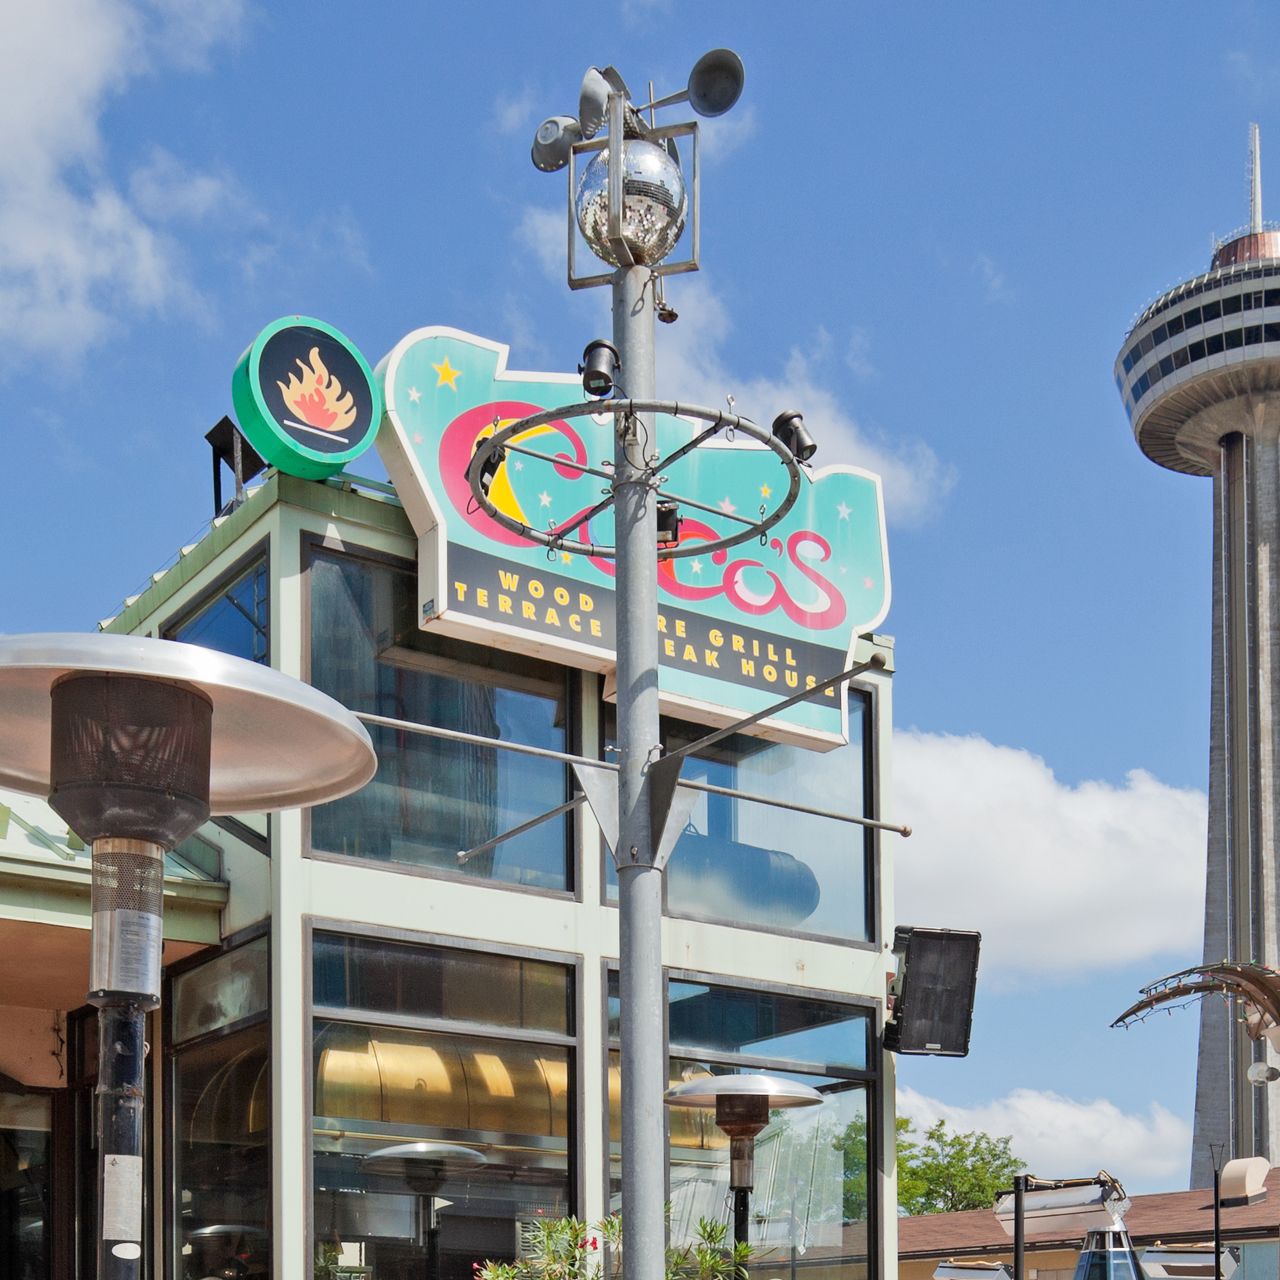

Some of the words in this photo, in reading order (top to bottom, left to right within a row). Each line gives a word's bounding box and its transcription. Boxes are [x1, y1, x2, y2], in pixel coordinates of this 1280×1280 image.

[454, 581, 602, 637] TERRACE
[664, 639, 720, 668] EAK
[498, 569, 594, 612] WOOD
[657, 614, 686, 638] RE
[709, 629, 797, 666] GRILL
